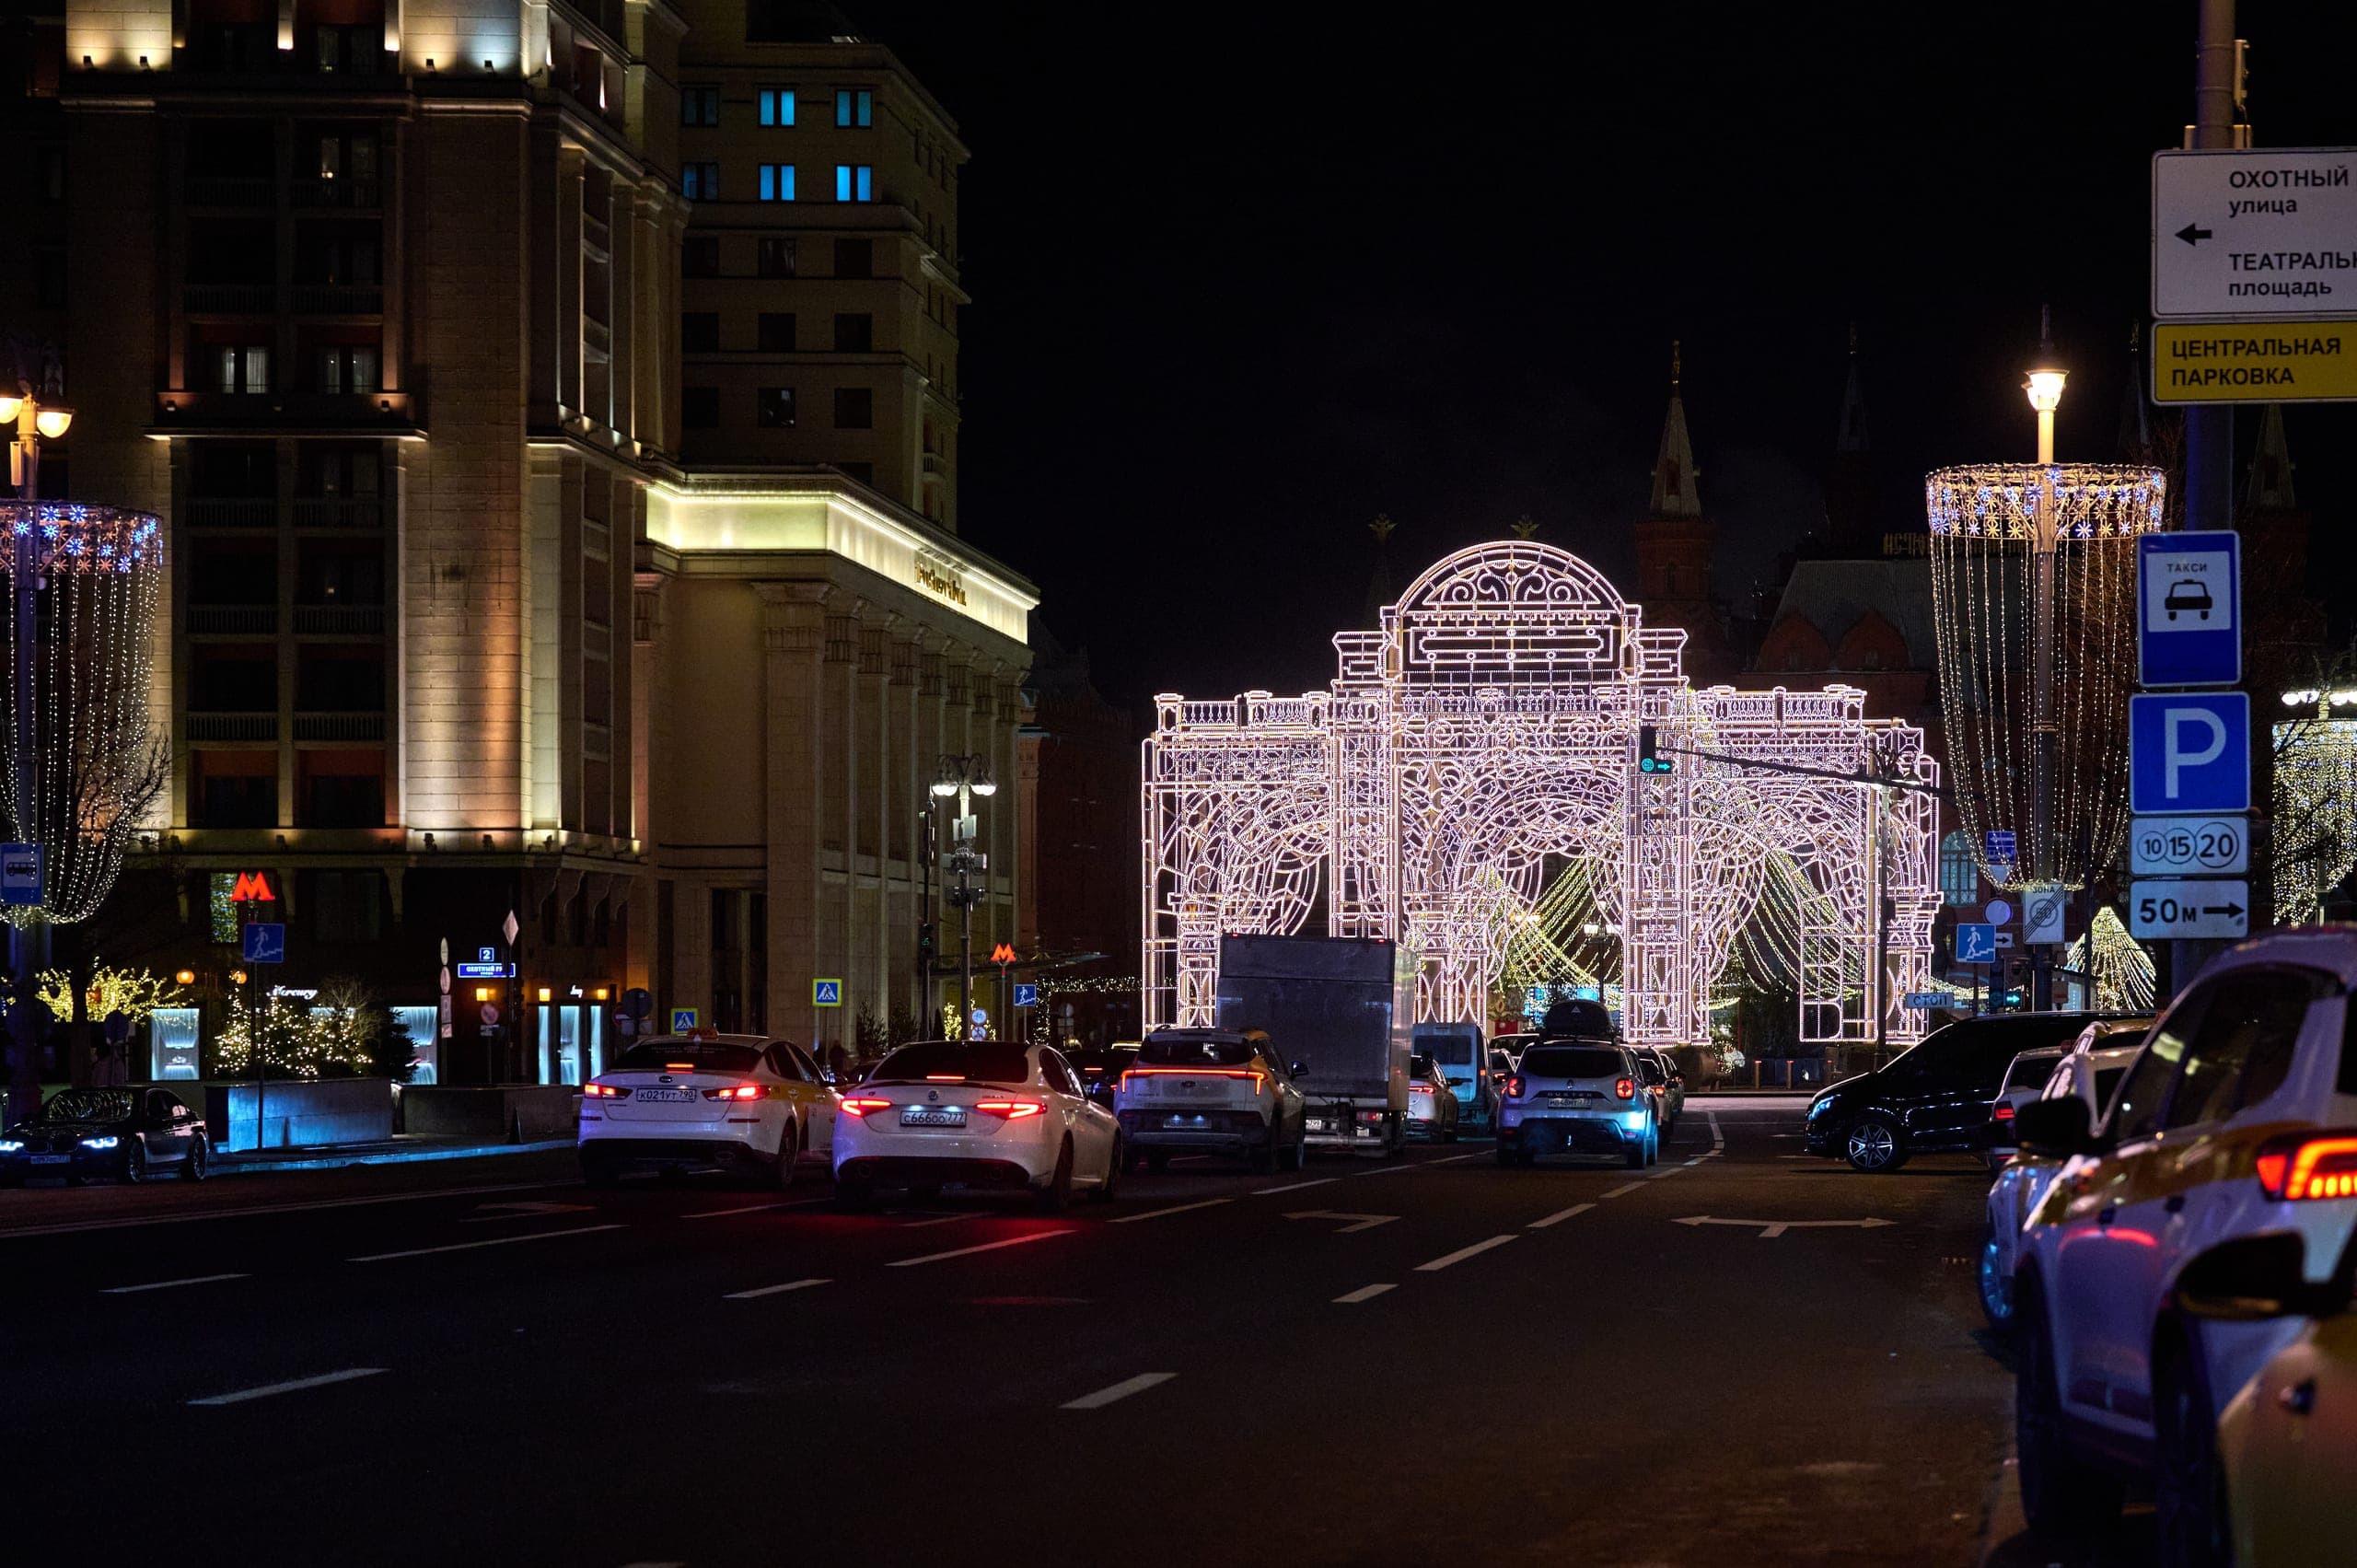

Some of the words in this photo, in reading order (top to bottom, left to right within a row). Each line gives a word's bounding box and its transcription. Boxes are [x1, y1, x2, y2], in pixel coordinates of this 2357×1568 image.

[2229, 165, 2349, 189] ОХОТНЫЙ
[2228, 199, 2297, 218] улица
[2228, 281, 2333, 297] площадь
[2171, 337, 2341, 360] ЦЕНТРАЛЬНАЯ
[2171, 367, 2295, 387] ПАРКОВКА
[2166, 563, 2208, 573] ТАКСИ
[2165, 707, 2227, 799] P
[2144, 839, 2162, 854] 10
[2169, 836, 2190, 856] 15
[2200, 833, 2234, 857] 20
[2139, 898, 2177, 923] 50
[482, 949, 491, 960] 2
[1913, 995, 1947, 1005] СТОП
